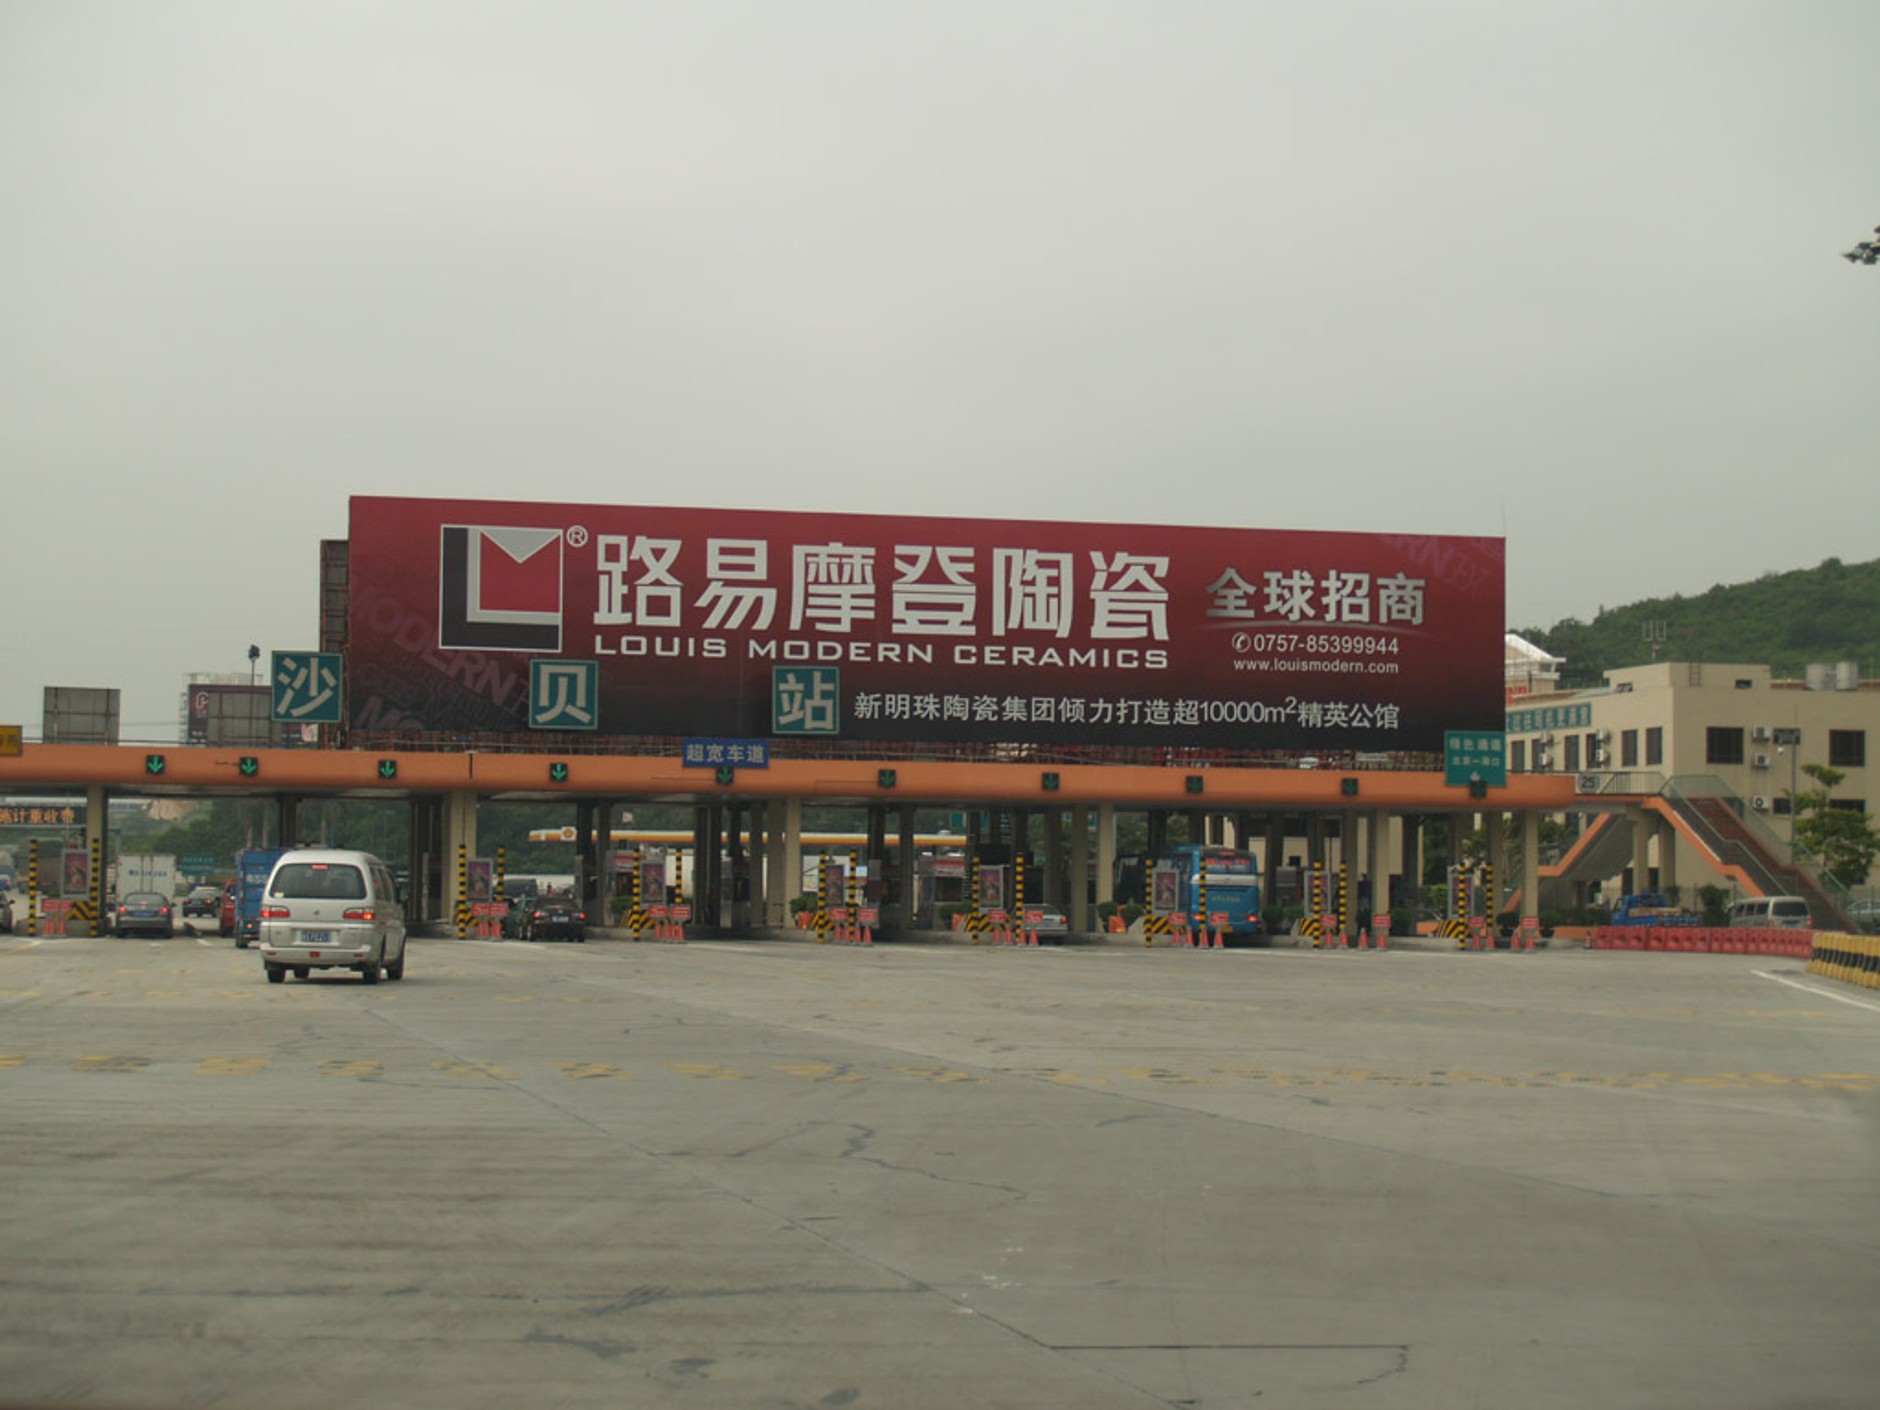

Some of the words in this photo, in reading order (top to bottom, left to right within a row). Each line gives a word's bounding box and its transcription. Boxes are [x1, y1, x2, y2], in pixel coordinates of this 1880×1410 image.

[593, 534, 1170, 641] 路易摩登陶瓷
[1206, 567, 1426, 624] 全球招商
[595, 634, 727, 659] LOUIS
[748, 638, 933, 664] MODERN
[954, 645, 1168, 670] CERAMICS
[1233, 657, 1400, 674] www.louismodern.com
[1253, 633, 1400, 655] 0757-85399944
[276, 657, 337, 717] 沙
[535, 664, 592, 725] 贝
[777, 673, 834, 729] 站
[686, 743, 764, 763] 超宽车道
